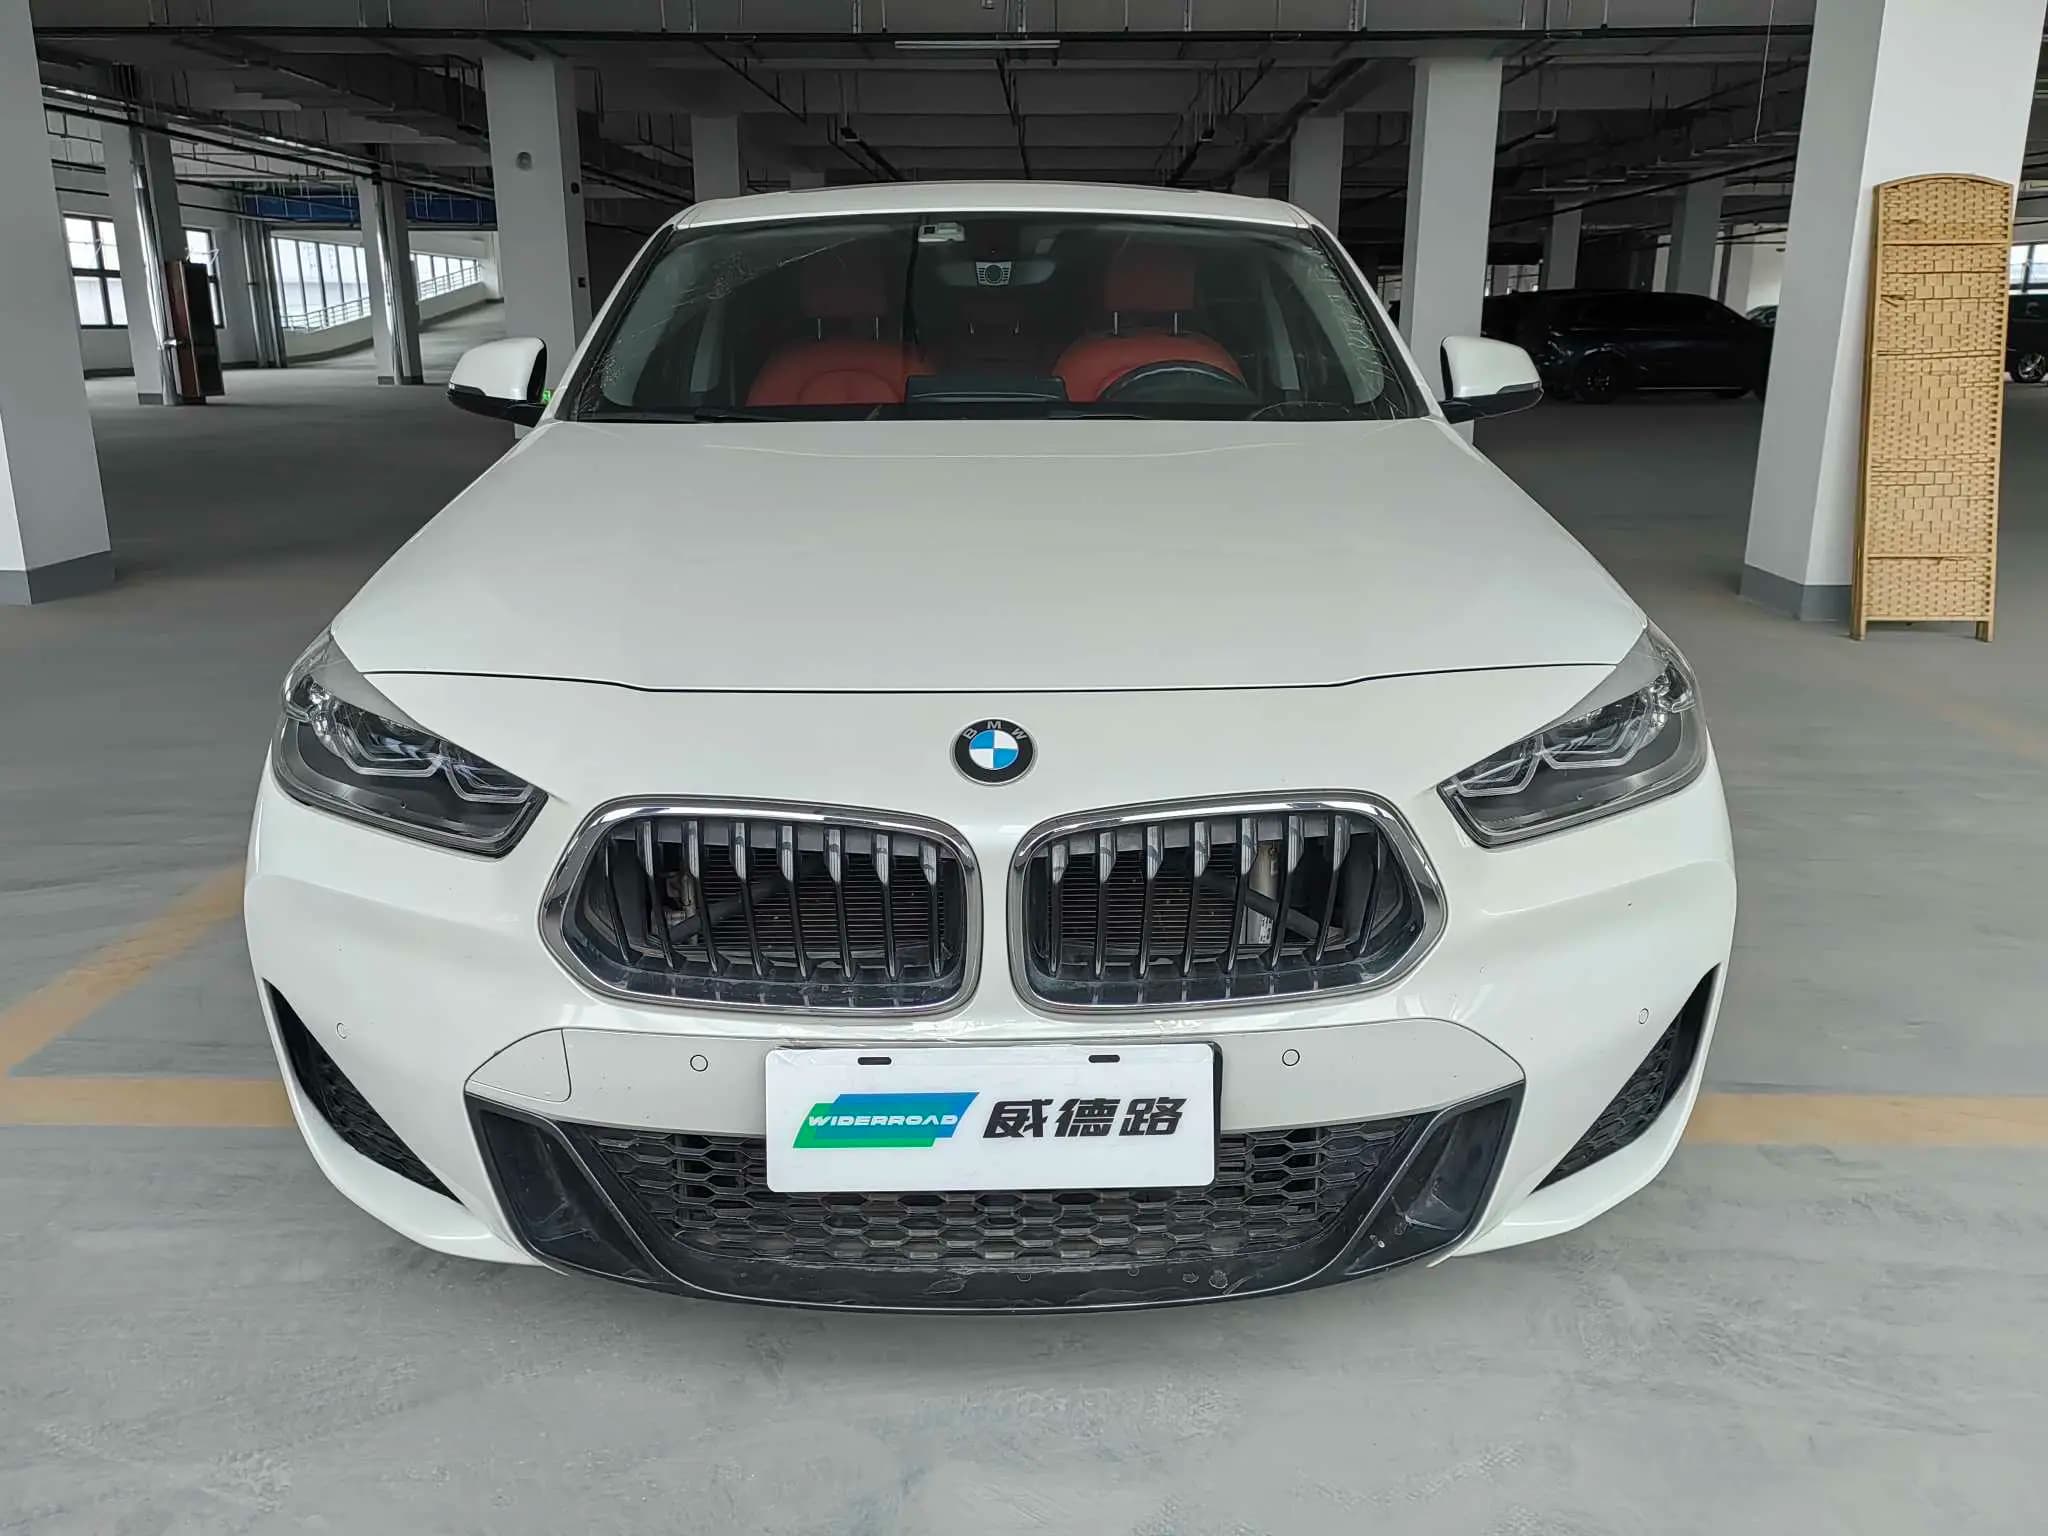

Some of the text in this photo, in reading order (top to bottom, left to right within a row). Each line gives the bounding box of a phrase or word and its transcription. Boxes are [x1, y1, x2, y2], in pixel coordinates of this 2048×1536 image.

[962, 720, 1028, 740] BMW
[808, 1114, 959, 1127] WIDERROAD
[983, 1097, 1187, 1138] 威德路
